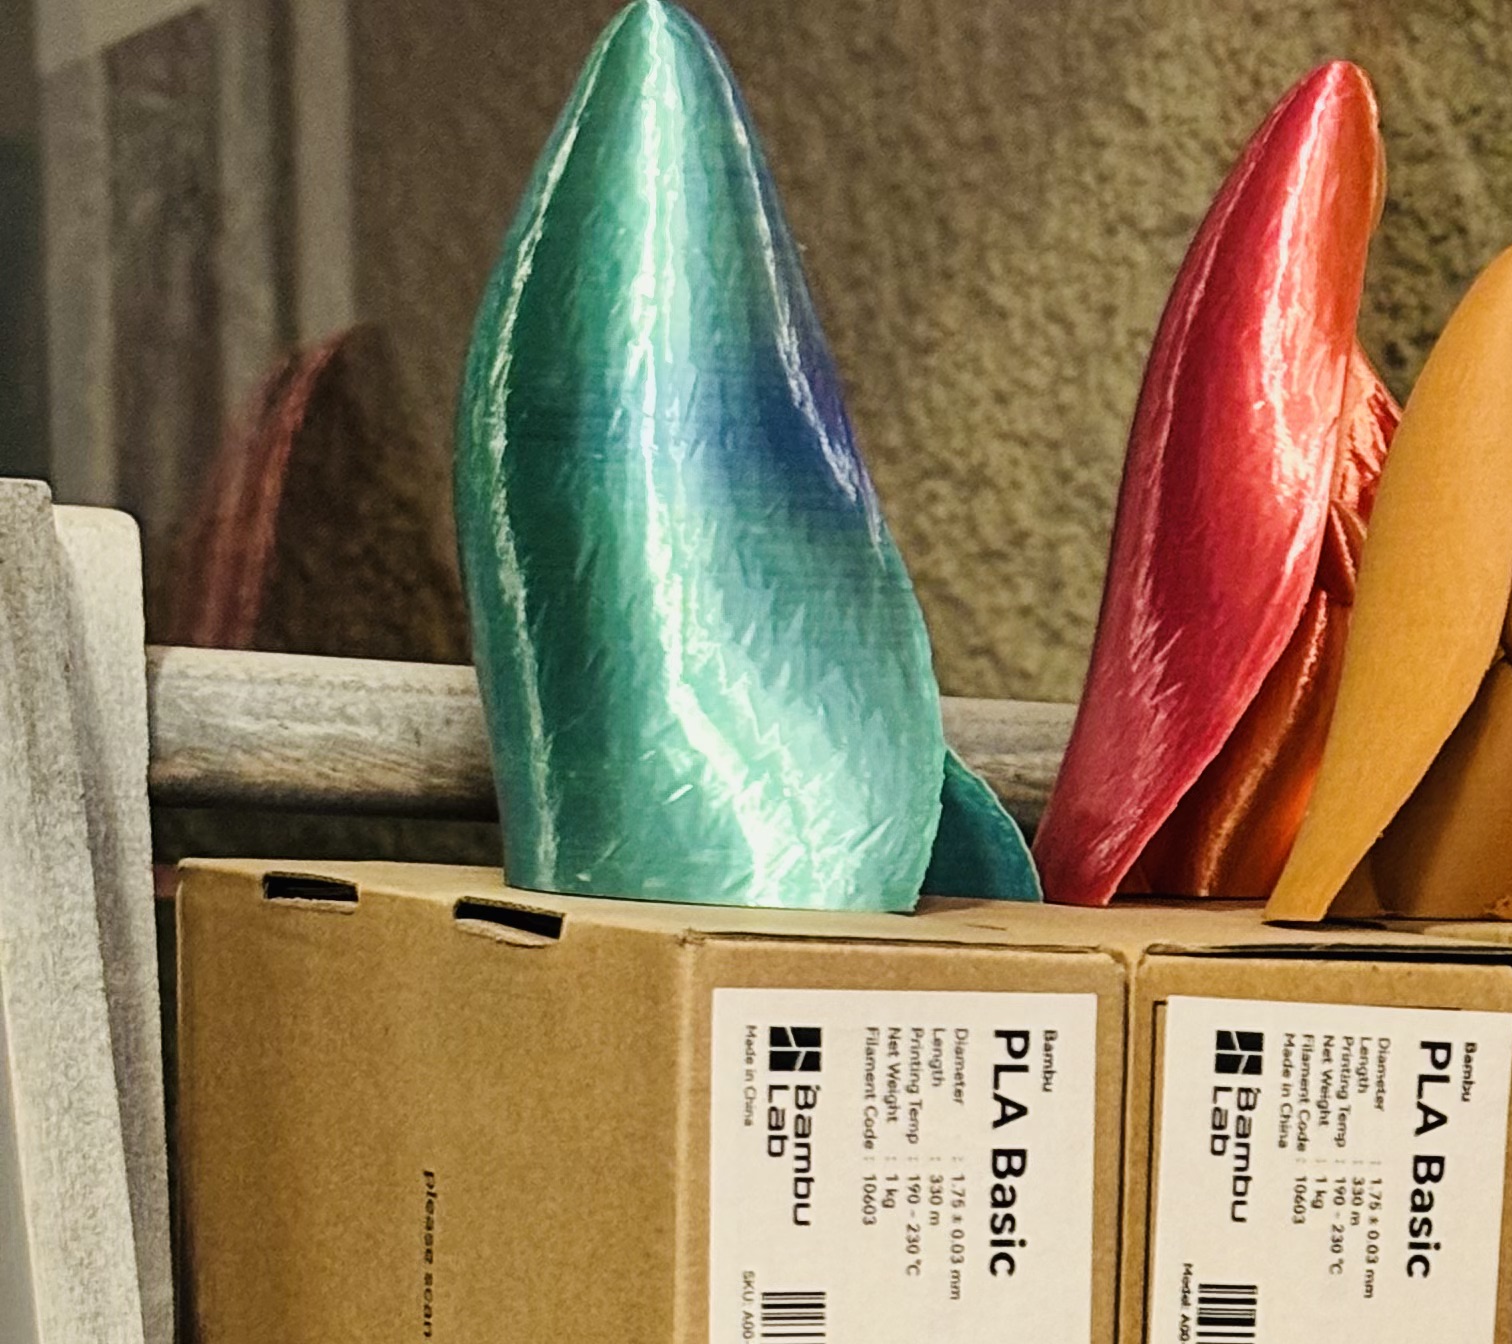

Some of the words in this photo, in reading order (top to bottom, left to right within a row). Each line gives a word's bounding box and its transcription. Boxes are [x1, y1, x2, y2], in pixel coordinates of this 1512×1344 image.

[744, 1024, 757, 1064] Made
[863, 1026, 879, 1099] Filament
[887, 1027, 901, 1057] Net
[904, 1027, 924, 1094] Printing
[927, 1027, 946, 1087] Length
[1041, 1029, 1057, 1092] Bambu
[1281, 1032, 1295, 1078] Made
[1321, 1034, 1334, 1063] Net
[1355, 1036, 1372, 1093] Length
[743, 1068, 755, 1082] in
[952, 1027, 968, 1104] Diameter
[991, 1029, 1029, 1129] PLA
[1298, 1034, 1314, 1103] Filament
[1335, 1035, 1354, 1100] Printing
[1373, 1037, 1390, 1111] Diameter
[1413, 1040, 1451, 1136] PLA
[1460, 1042, 1477, 1102] Bambu
[743, 1085, 756, 1126] China
[882, 1062, 900, 1122] Weight
[1280, 1082, 1291, 1097] in
[1315, 1069, 1332, 1126] Weight
[766, 1084, 789, 1157] Lab
[862, 1105, 877, 1149] Code
[904, 1099, 922, 1144] Temp
[1209, 1085, 1232, 1156] Lab
[1277, 1102, 1292, 1148] China
[1296, 1109, 1310, 1152] Code
[1333, 1105, 1351, 1148] Temp
[792, 1084, 820, 1226] Bambu
[1230, 1086, 1261, 1222] Bambu
[861, 1174, 876, 1225] 10603
[881, 1188, 898, 1208] kg
[906, 1175, 920, 1204] 190
[928, 1175, 943, 1205] 330
[950, 1174, 965, 1208] 1.75
[989, 1148, 1027, 1276] Basic
[1292, 1176, 1306, 1224] 10603
[1310, 1190, 1326, 1209] kg
[1332, 1177, 1346, 1206] 190
[1350, 1177, 1364, 1206] 330
[1368, 1178, 1382, 1210] 1.75
[423, 1171, 437, 1264] please
[905, 1223, 920, 1254] 230
[928, 1210, 939, 1226] m
[1349, 1211, 1359, 1226] m
[1405, 1154, 1445, 1278] Basic
[949, 1228, 964, 1264] 0.03
[1330, 1224, 1344, 1254] 230
[1365, 1230, 1379, 1264] 0.03
[424, 1273, 432, 1337] scan
[949, 1269, 960, 1300] mm
[1363, 1269, 1374, 1298] mm
